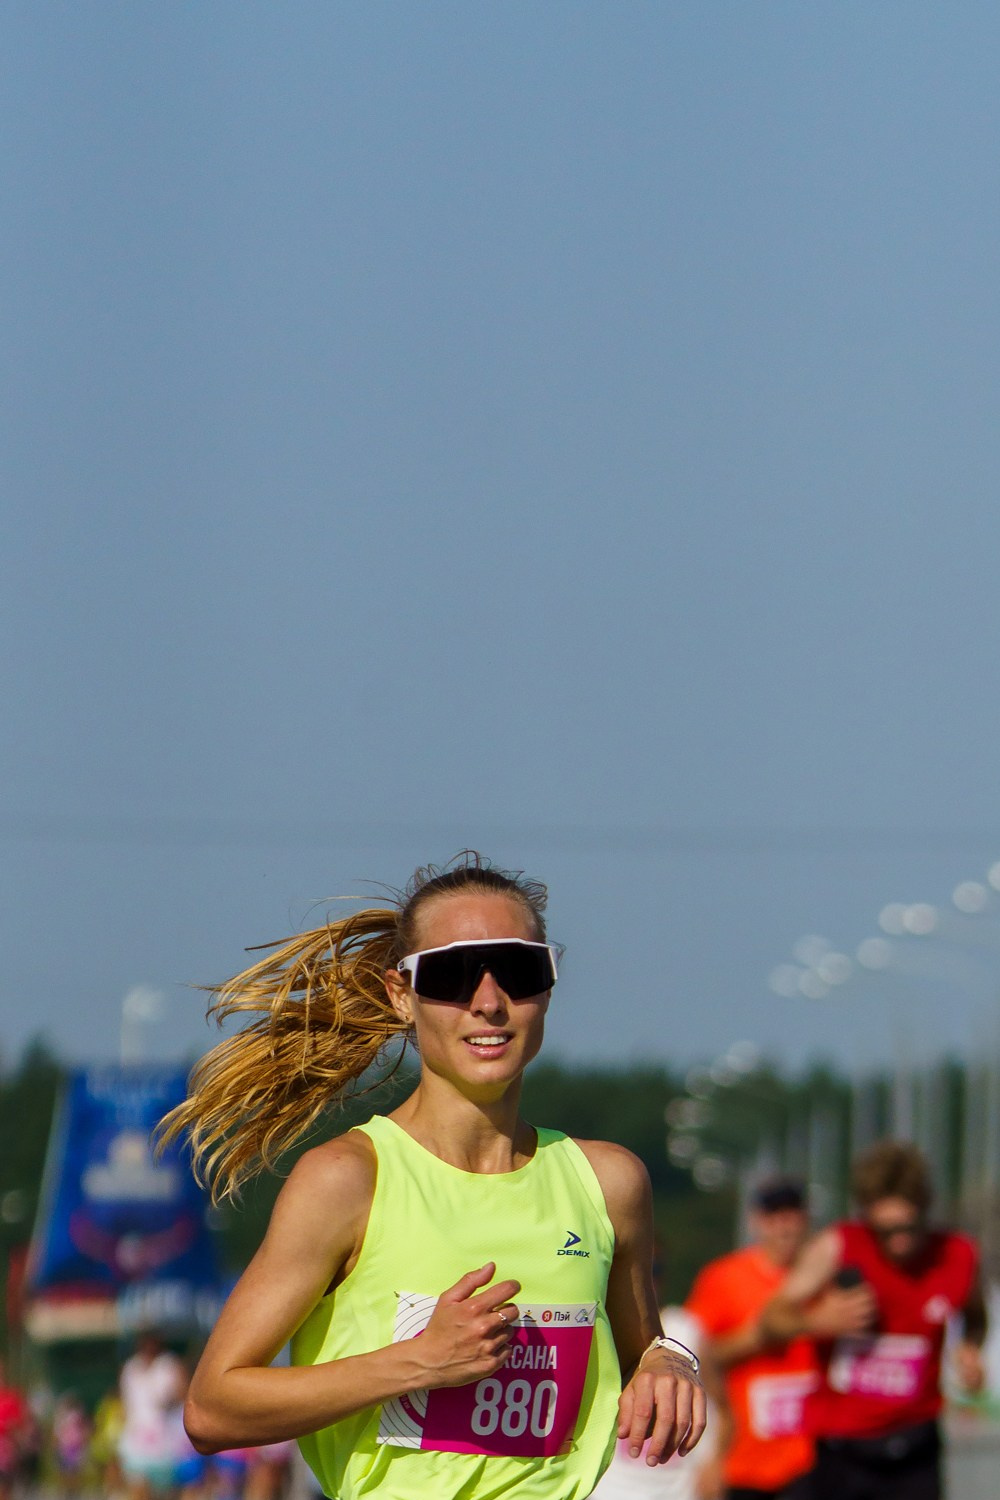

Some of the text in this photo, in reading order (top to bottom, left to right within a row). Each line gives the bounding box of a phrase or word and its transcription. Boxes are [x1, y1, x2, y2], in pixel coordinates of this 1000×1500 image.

[557, 1249, 590, 1258] DEMIX
[554, 1311, 570, 1321] Пэй
[470, 1378, 559, 1438] 880
